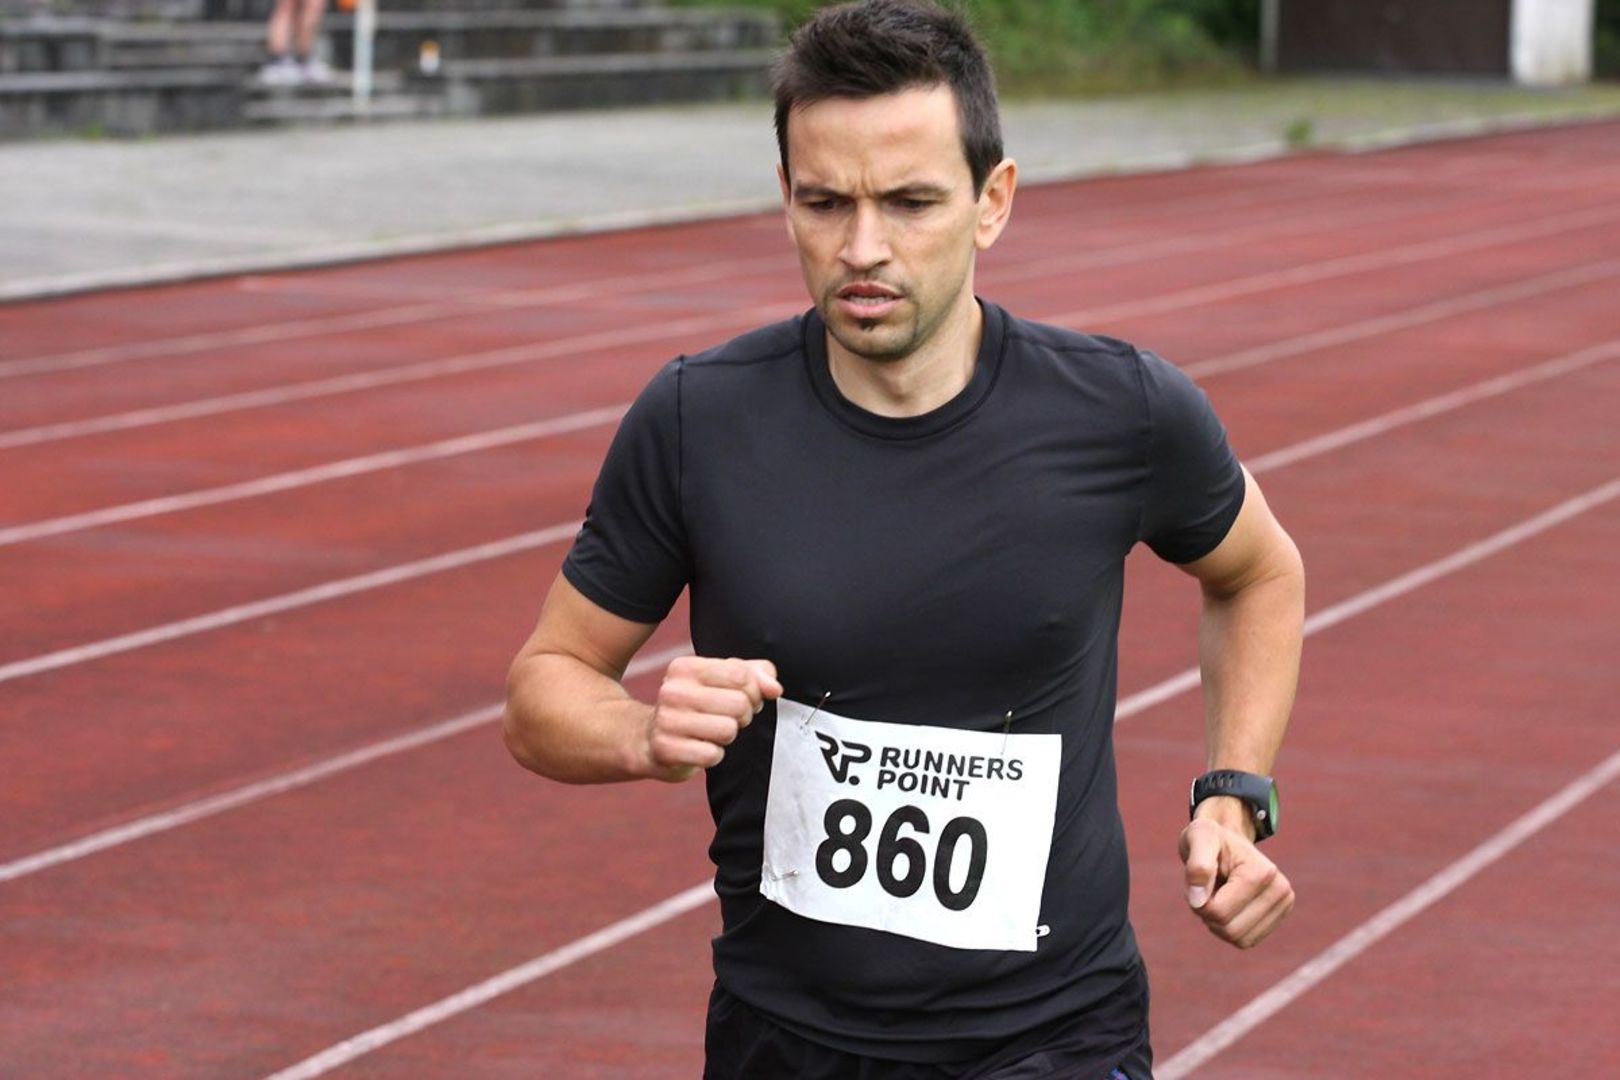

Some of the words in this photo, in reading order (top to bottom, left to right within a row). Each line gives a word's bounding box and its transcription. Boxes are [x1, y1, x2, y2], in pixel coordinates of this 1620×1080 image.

[879, 746, 1024, 781] RUNNERS
[877, 769, 971, 801] POINT
[815, 799, 988, 911] 860
